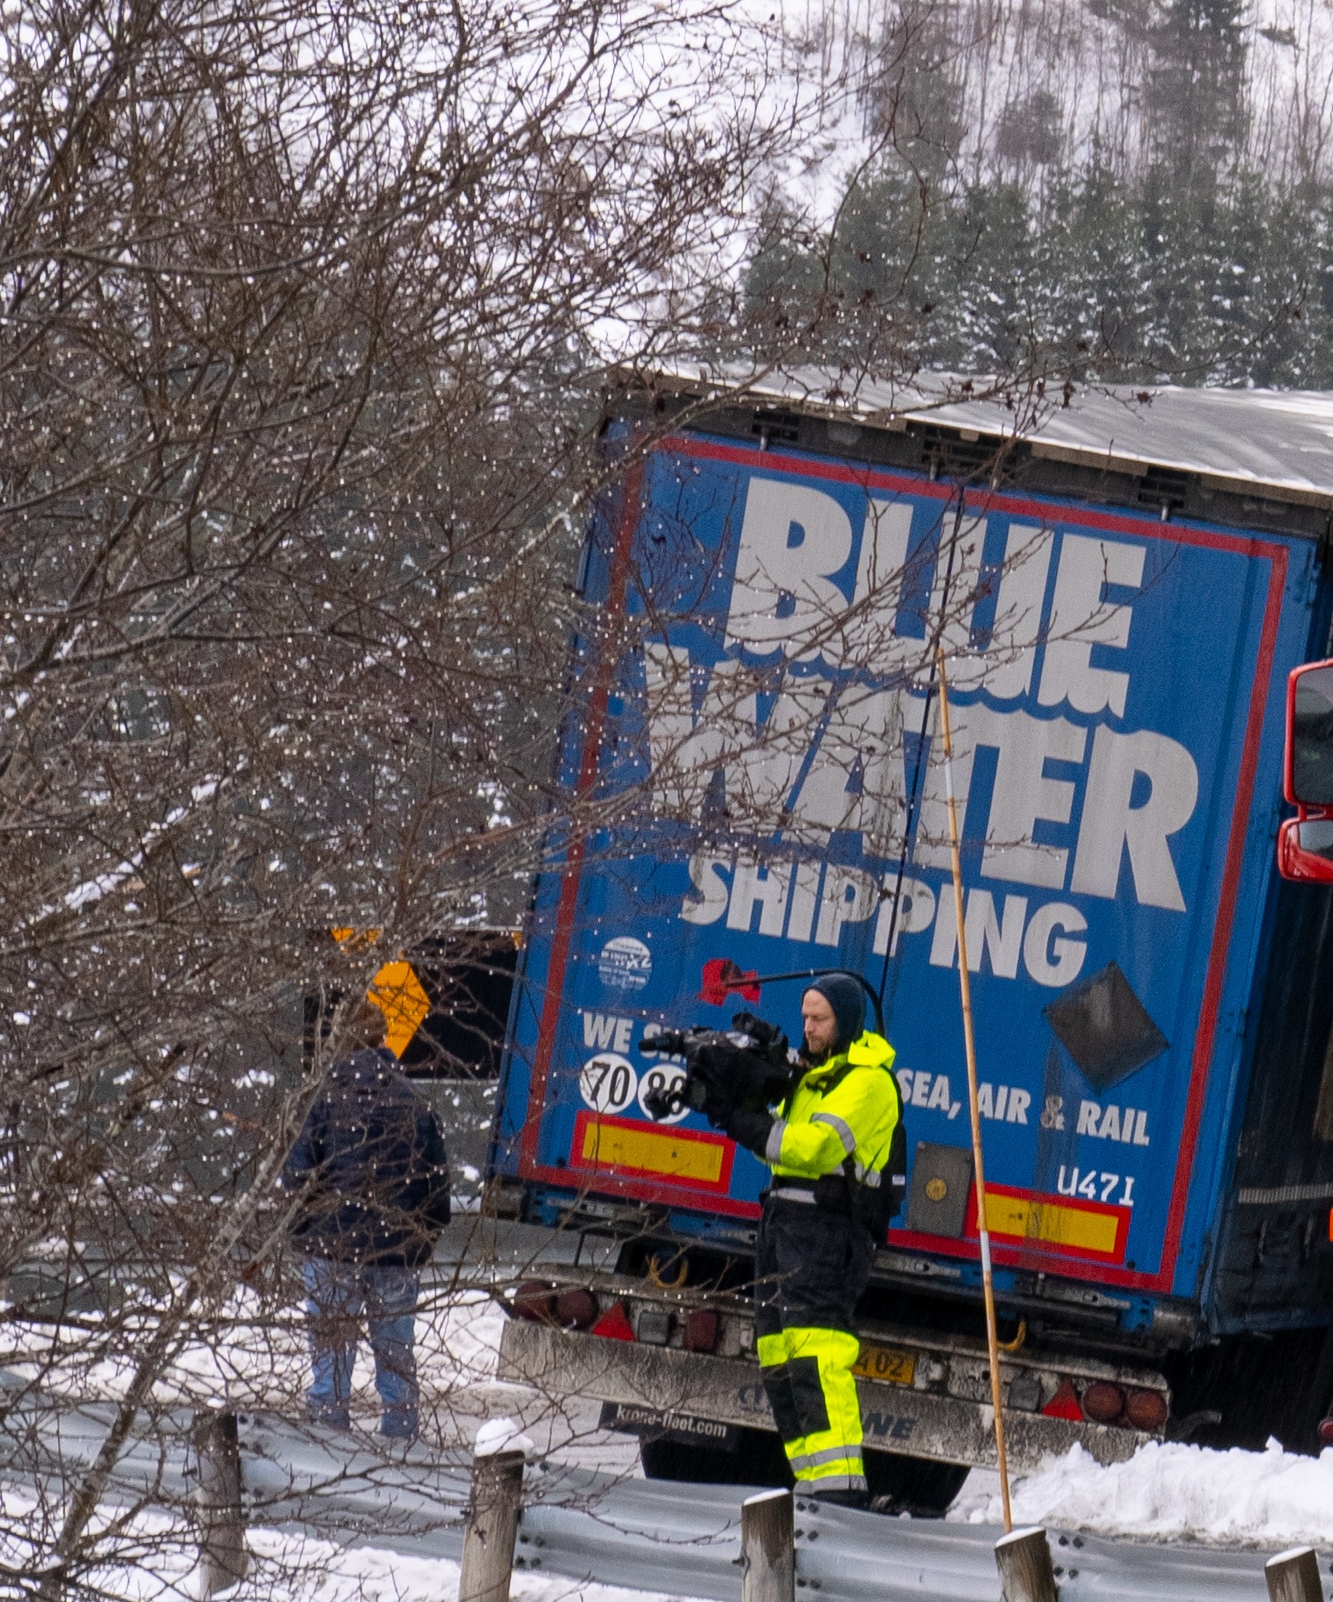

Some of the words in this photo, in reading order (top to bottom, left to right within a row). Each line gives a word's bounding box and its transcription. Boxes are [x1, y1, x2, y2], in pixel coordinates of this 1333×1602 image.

[724, 476, 1147, 719] BLUE
[644, 639, 1200, 913] WATER
[681, 844, 1088, 988] SHIPPING
[583, 1011, 634, 1054] WE
[589, 1061, 631, 1106] 70
[896, 1068, 961, 1120] SEA,
[977, 1082, 1032, 1125] AIR
[1041, 1096, 1065, 1131] &
[1076, 1099, 1151, 1146] RAIL
[616, 1404, 728, 1438] krone-fleet.com
